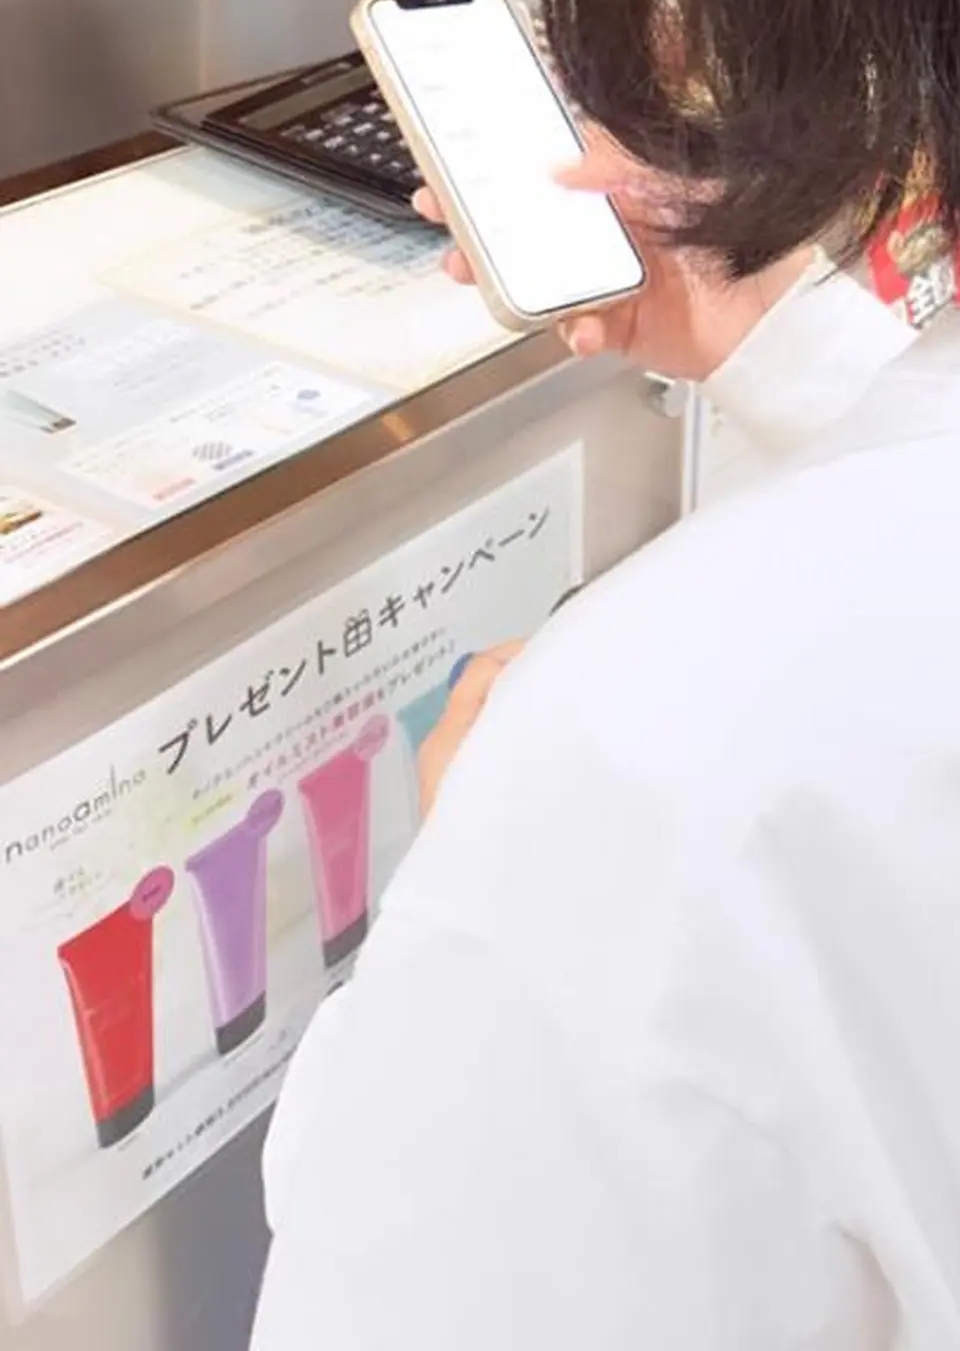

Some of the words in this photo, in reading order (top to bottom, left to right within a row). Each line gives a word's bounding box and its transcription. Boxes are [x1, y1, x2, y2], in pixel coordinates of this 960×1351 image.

[157, 640, 336, 775] プレゼント
